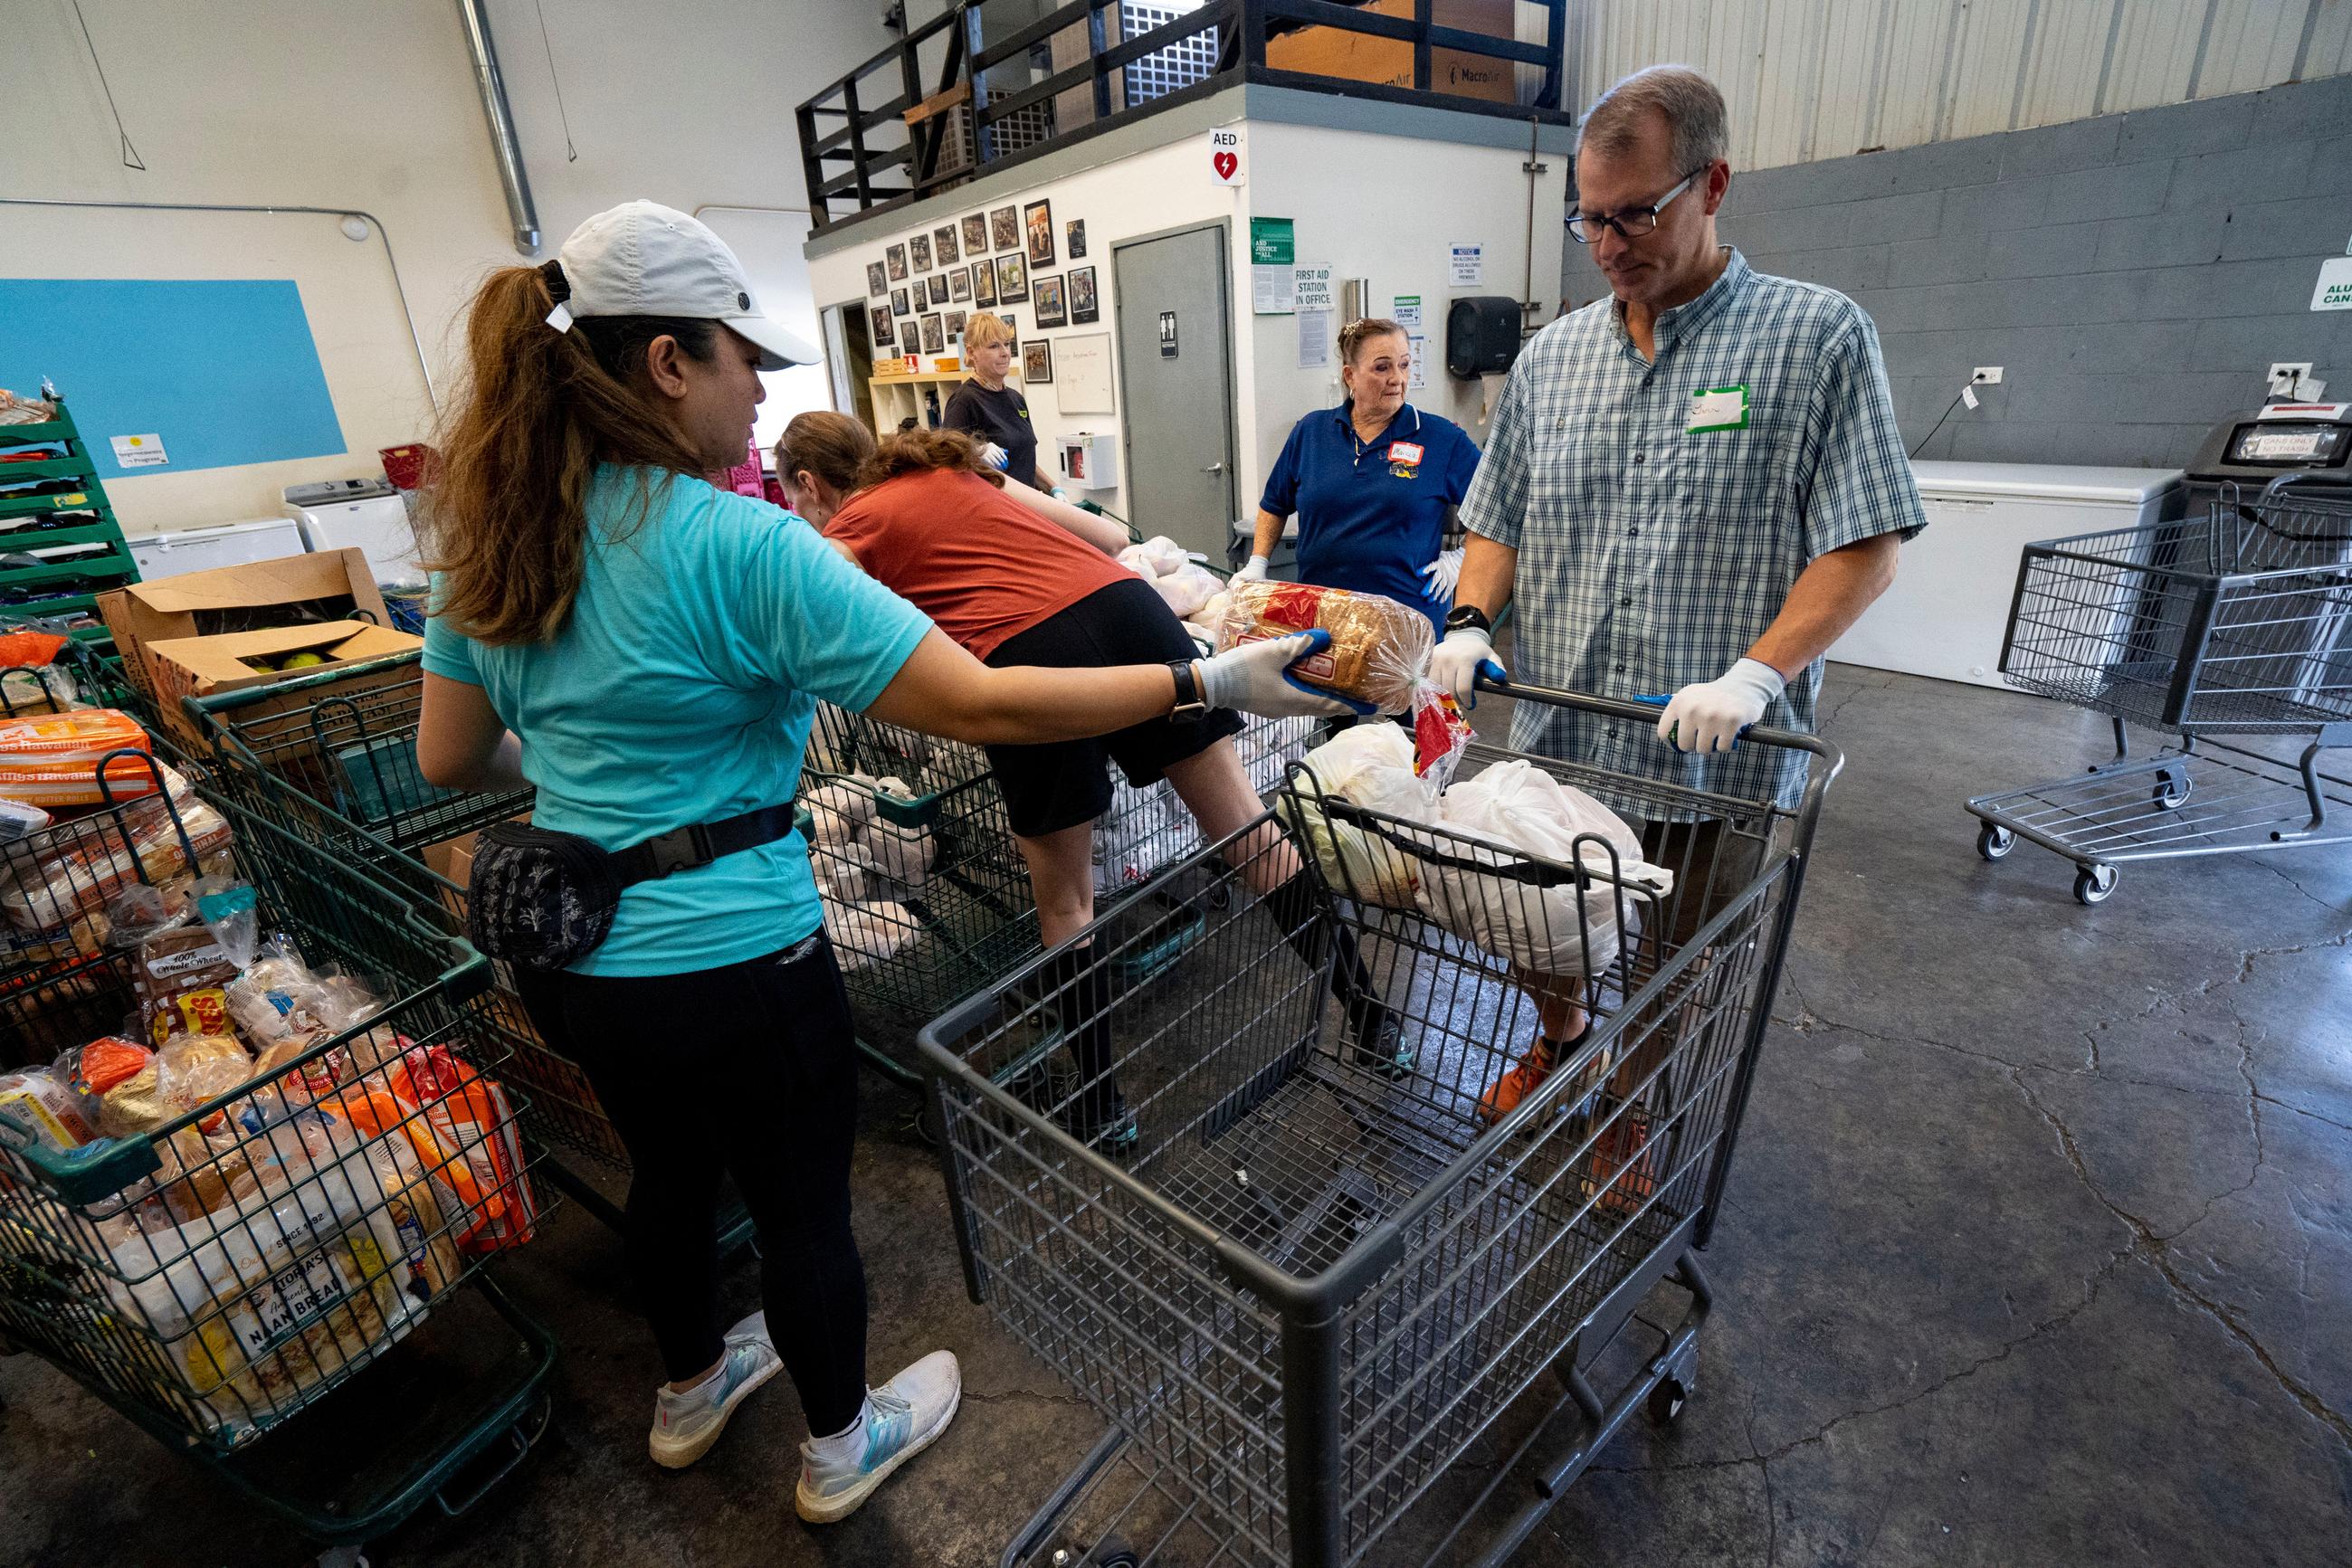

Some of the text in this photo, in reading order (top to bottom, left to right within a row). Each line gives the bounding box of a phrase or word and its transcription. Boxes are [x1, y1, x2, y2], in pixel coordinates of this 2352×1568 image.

[1214, 133, 1237, 145] AED
[1296, 271, 1328, 280] FIRST AID
[1299, 282, 1327, 292] STATION
[1296, 294, 1330, 305] IN OFFICE
[2324, 294, 2352, 303] CAN
[173, 951, 197, 963] 100%
[157, 954, 223, 974] Whole Wheat
[276, 1229, 302, 1249] SINCE
